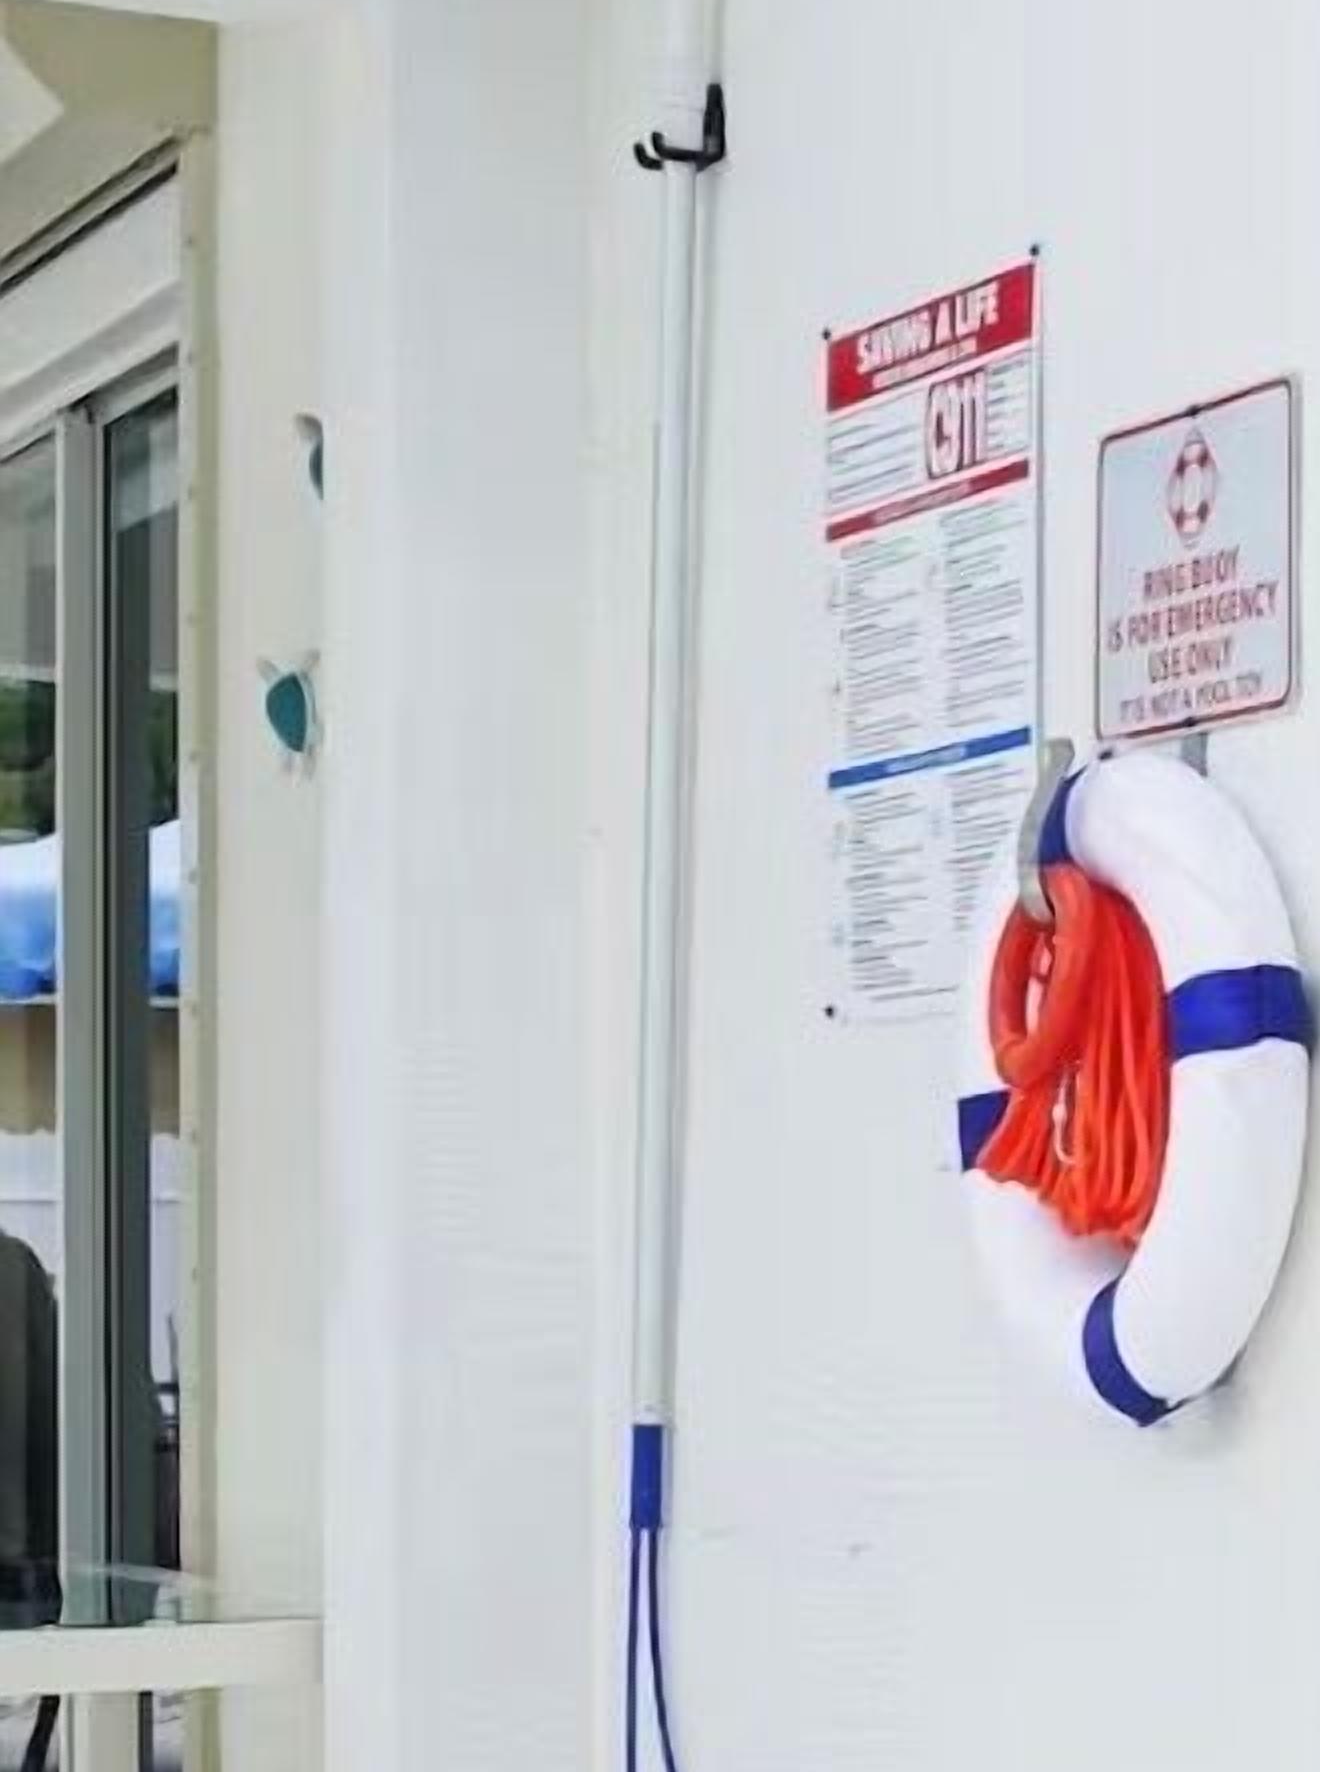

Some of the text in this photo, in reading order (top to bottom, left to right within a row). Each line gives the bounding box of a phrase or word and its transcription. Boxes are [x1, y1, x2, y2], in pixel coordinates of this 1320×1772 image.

[935, 301, 952, 345] A
[955, 281, 999, 336] LIFE
[1192, 545, 1240, 590] BUOY
[1108, 581, 1279, 652] IS FOR EMERGENCY
[1149, 636, 1233, 683] USE ONLY
